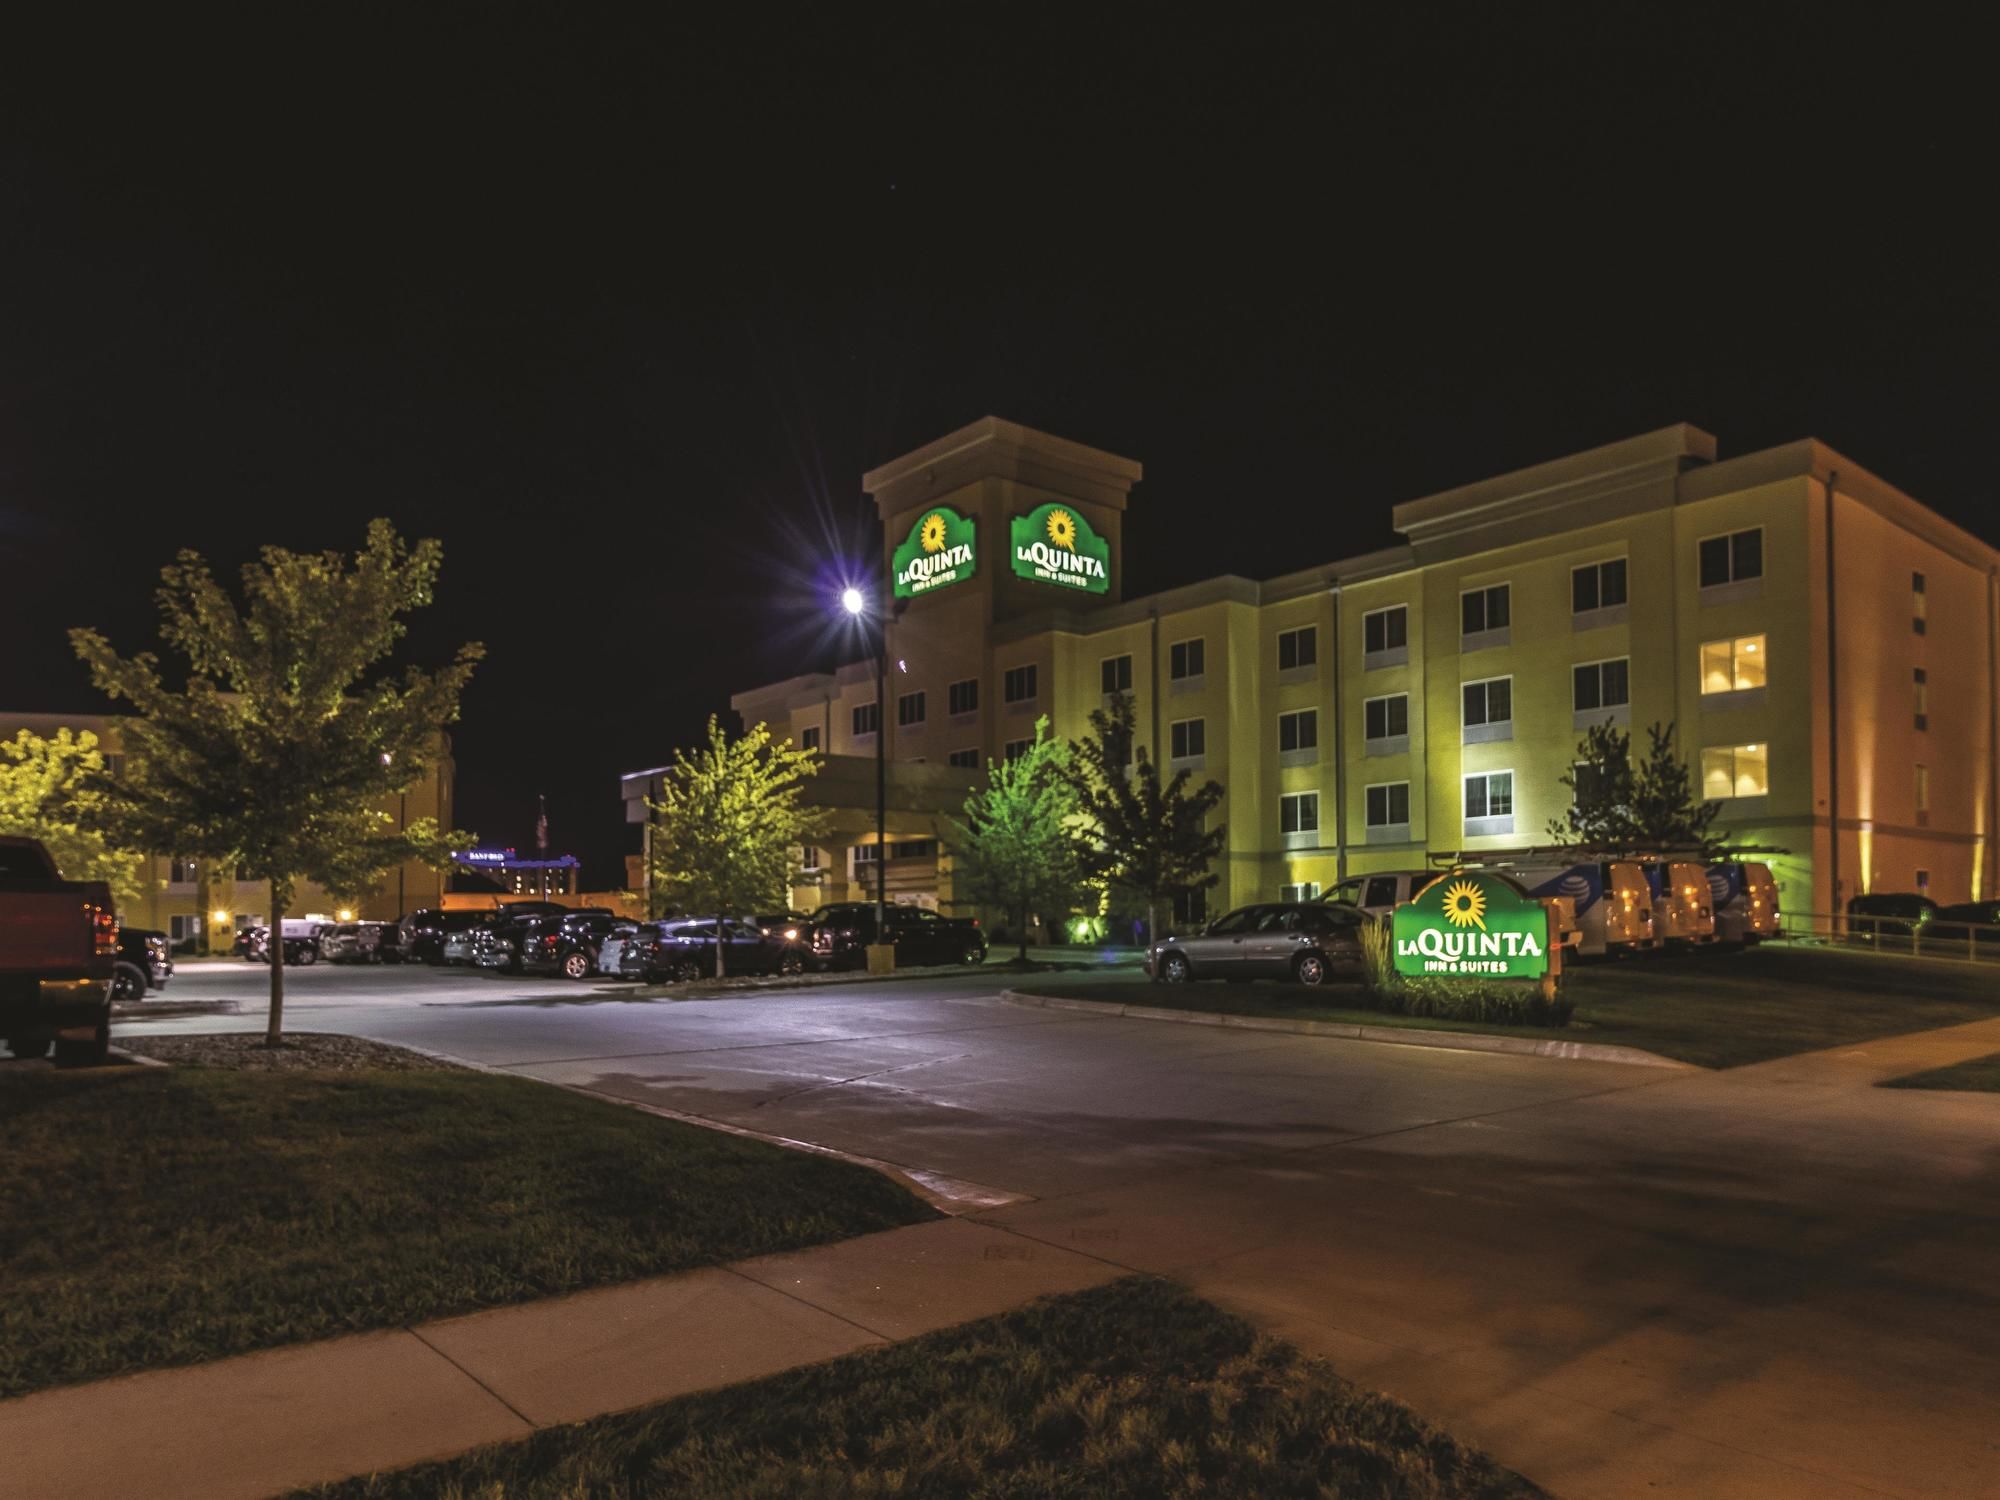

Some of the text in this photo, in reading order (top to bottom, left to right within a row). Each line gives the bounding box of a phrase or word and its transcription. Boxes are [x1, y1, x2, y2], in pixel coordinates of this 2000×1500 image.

[912, 579, 926, 592] INN
[930, 570, 957, 588] SUITES
[1034, 567, 1051, 578] INN
[1057, 572, 1088, 587] SUITES
[1424, 961, 1509, 974] INN & SUITES
